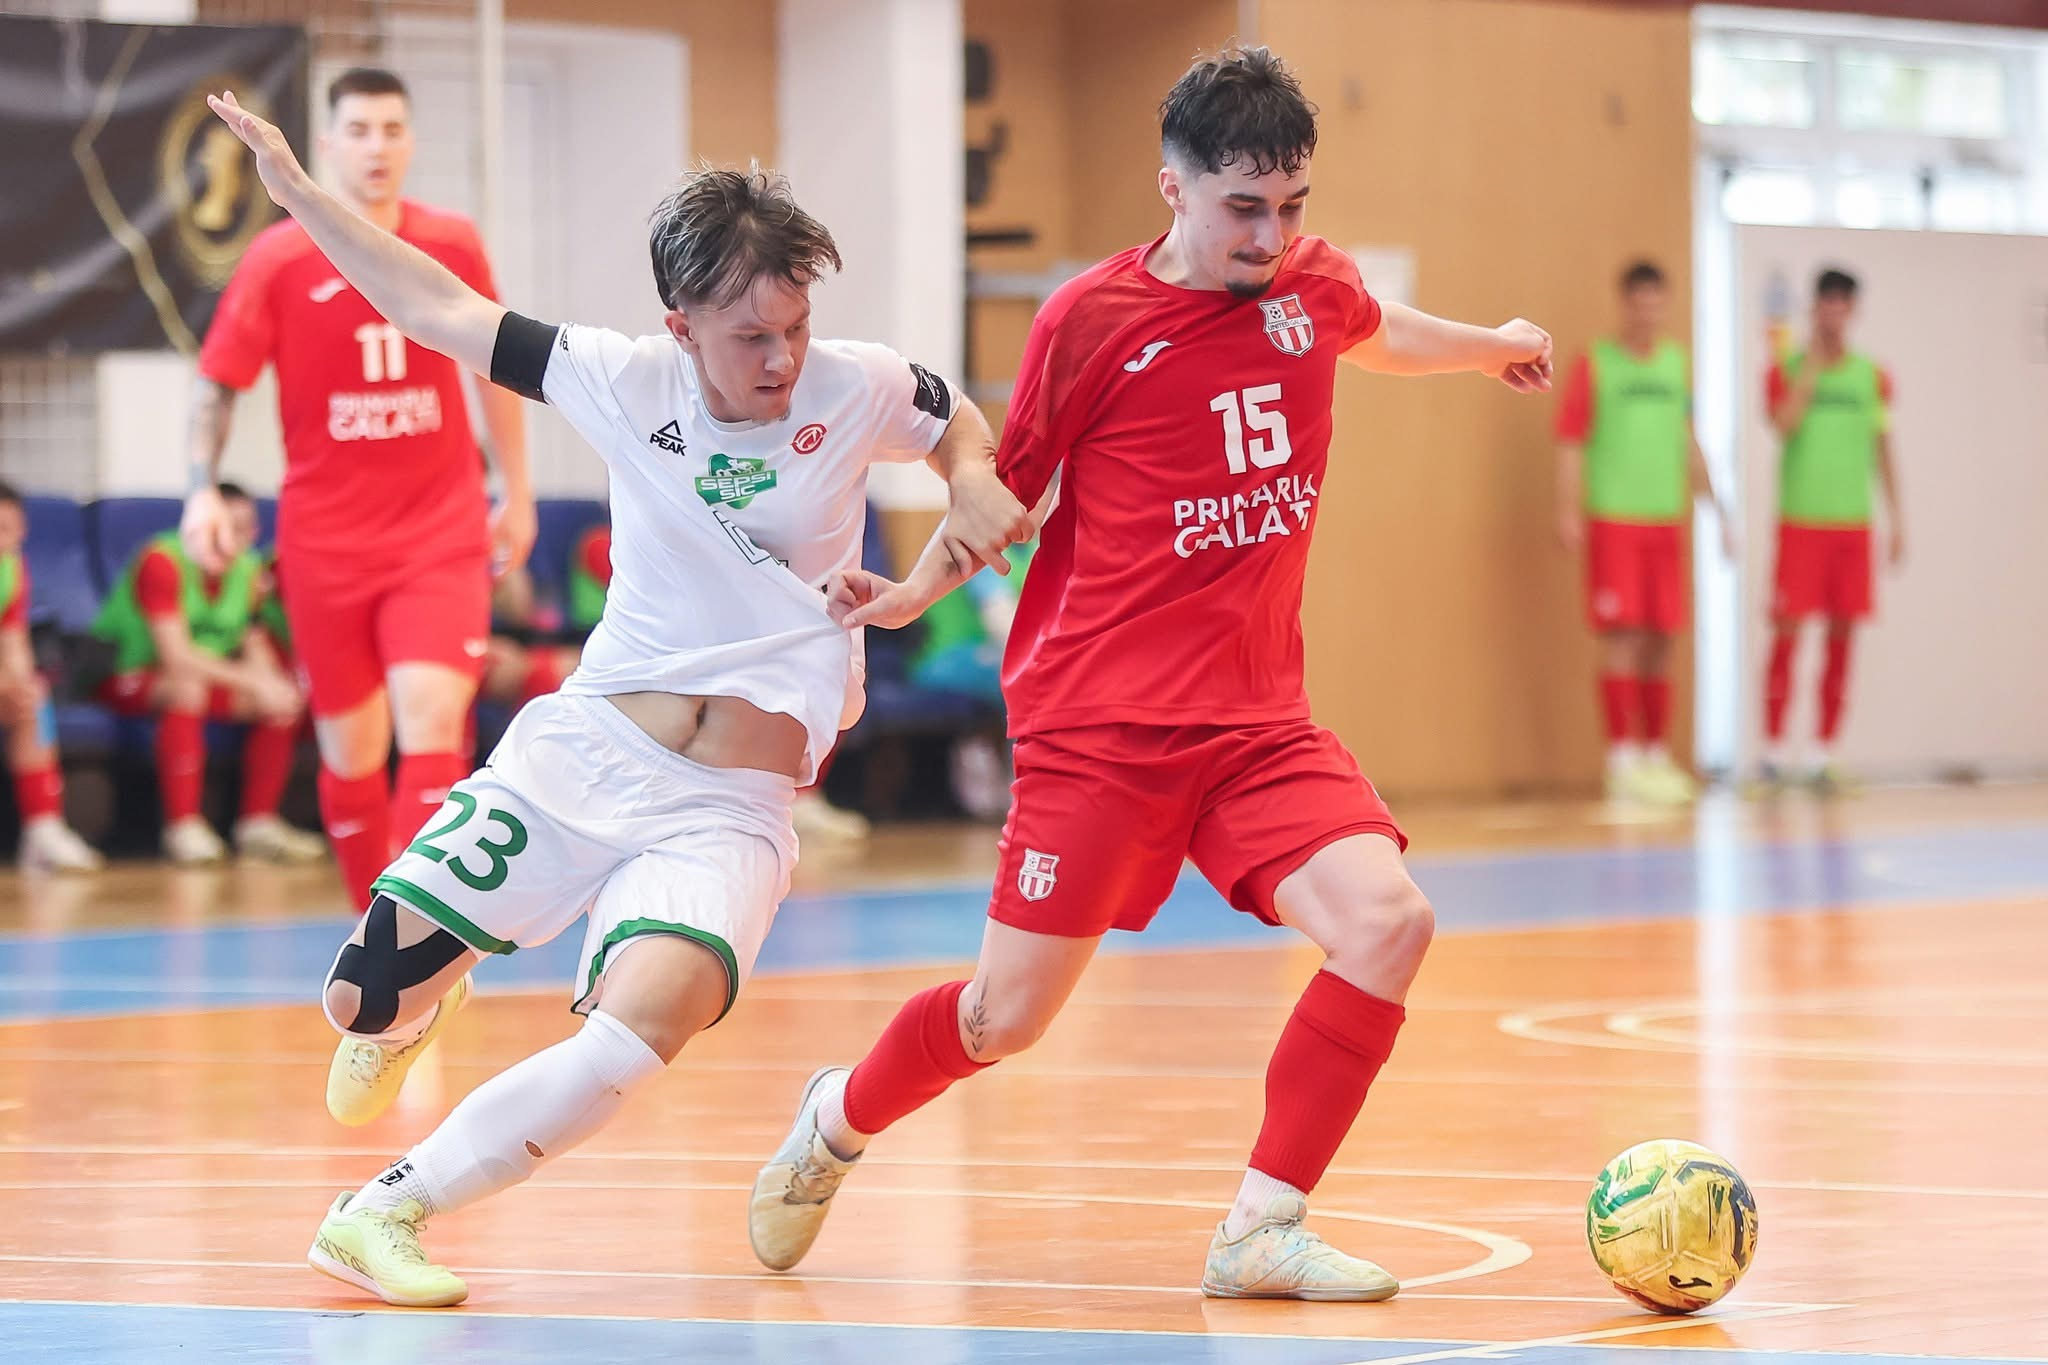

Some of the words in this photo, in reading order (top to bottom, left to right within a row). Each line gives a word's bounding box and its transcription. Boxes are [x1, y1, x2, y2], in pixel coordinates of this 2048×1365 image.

[354, 321, 407, 383] 11
[650, 433, 687, 457] PEAK
[1209, 382, 1293, 475] 15
[701, 472, 772, 491] SEPSI
[720, 485, 756, 501] SIC
[407, 791, 528, 892] 23
